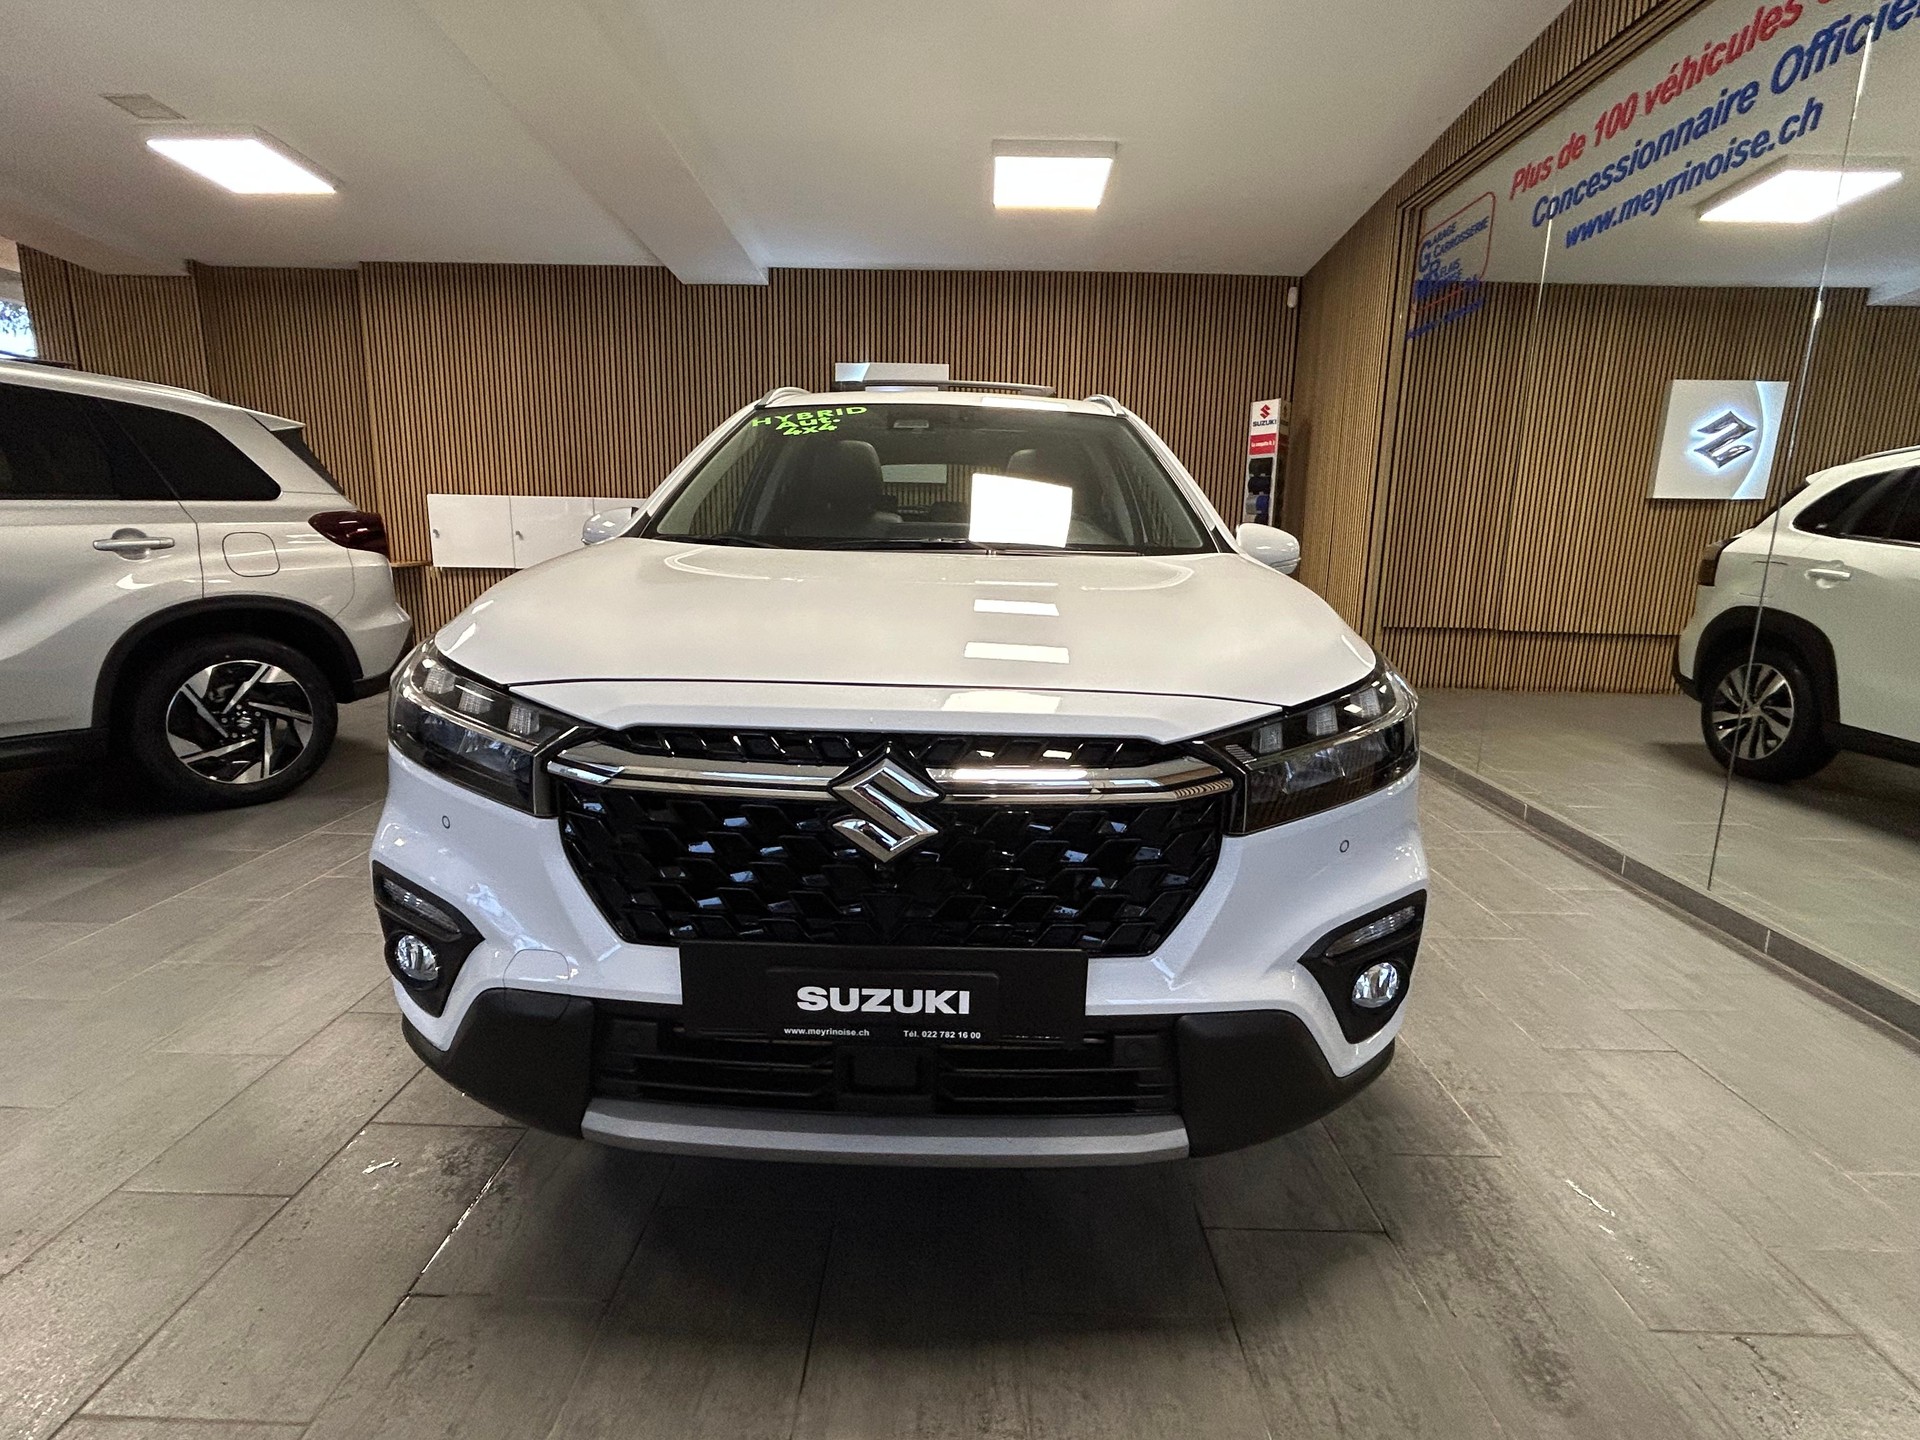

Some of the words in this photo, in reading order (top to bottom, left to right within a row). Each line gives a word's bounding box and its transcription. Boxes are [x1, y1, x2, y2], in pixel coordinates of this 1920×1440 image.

[1510, 156, 1553, 200] Plus
[1557, 132, 1586, 169] de
[1594, 92, 1639, 147] 100
[1644, 0, 1803, 116] véhicules
[1532, 81, 1760, 228] Concessionnaire
[1771, 0, 1920, 94] Officie
[1565, 98, 1824, 249] www.meyrinoise.ch
[752, 406, 868, 427] HYBRID
[1252, 419, 1277, 427] SUZUKI
[783, 423, 838, 436] 4x4
[797, 986, 970, 1015] SUZUKI
[784, 1027, 870, 1037] www.meyrinoise.ch
[922, 1031, 938, 1039] 022
[940, 1031, 956, 1039] 782
[958, 1031, 969, 1039] 16
